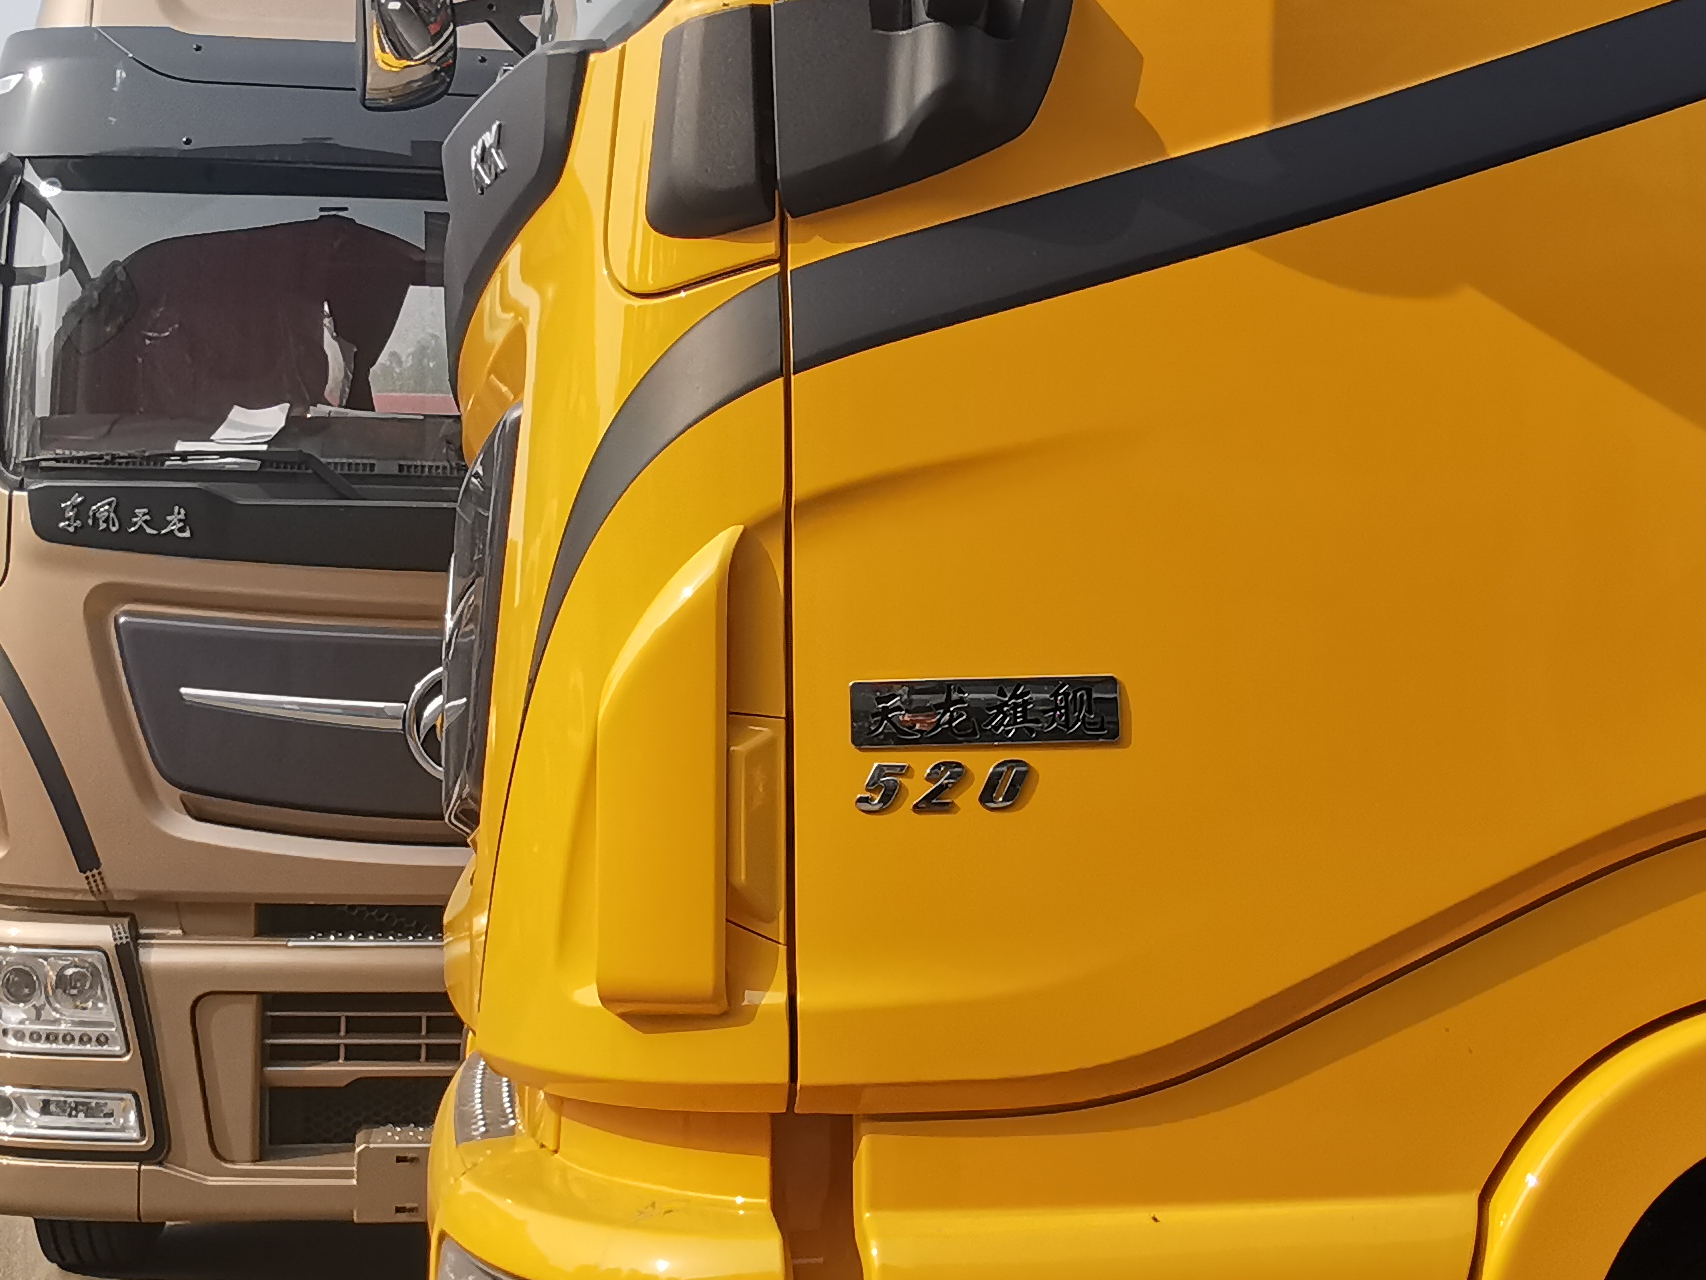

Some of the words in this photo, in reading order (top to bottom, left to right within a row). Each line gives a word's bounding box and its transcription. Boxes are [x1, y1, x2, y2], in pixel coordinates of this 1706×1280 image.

[867, 681, 1108, 740] 天龙旗舰
[855, 758, 1030, 813] 520
